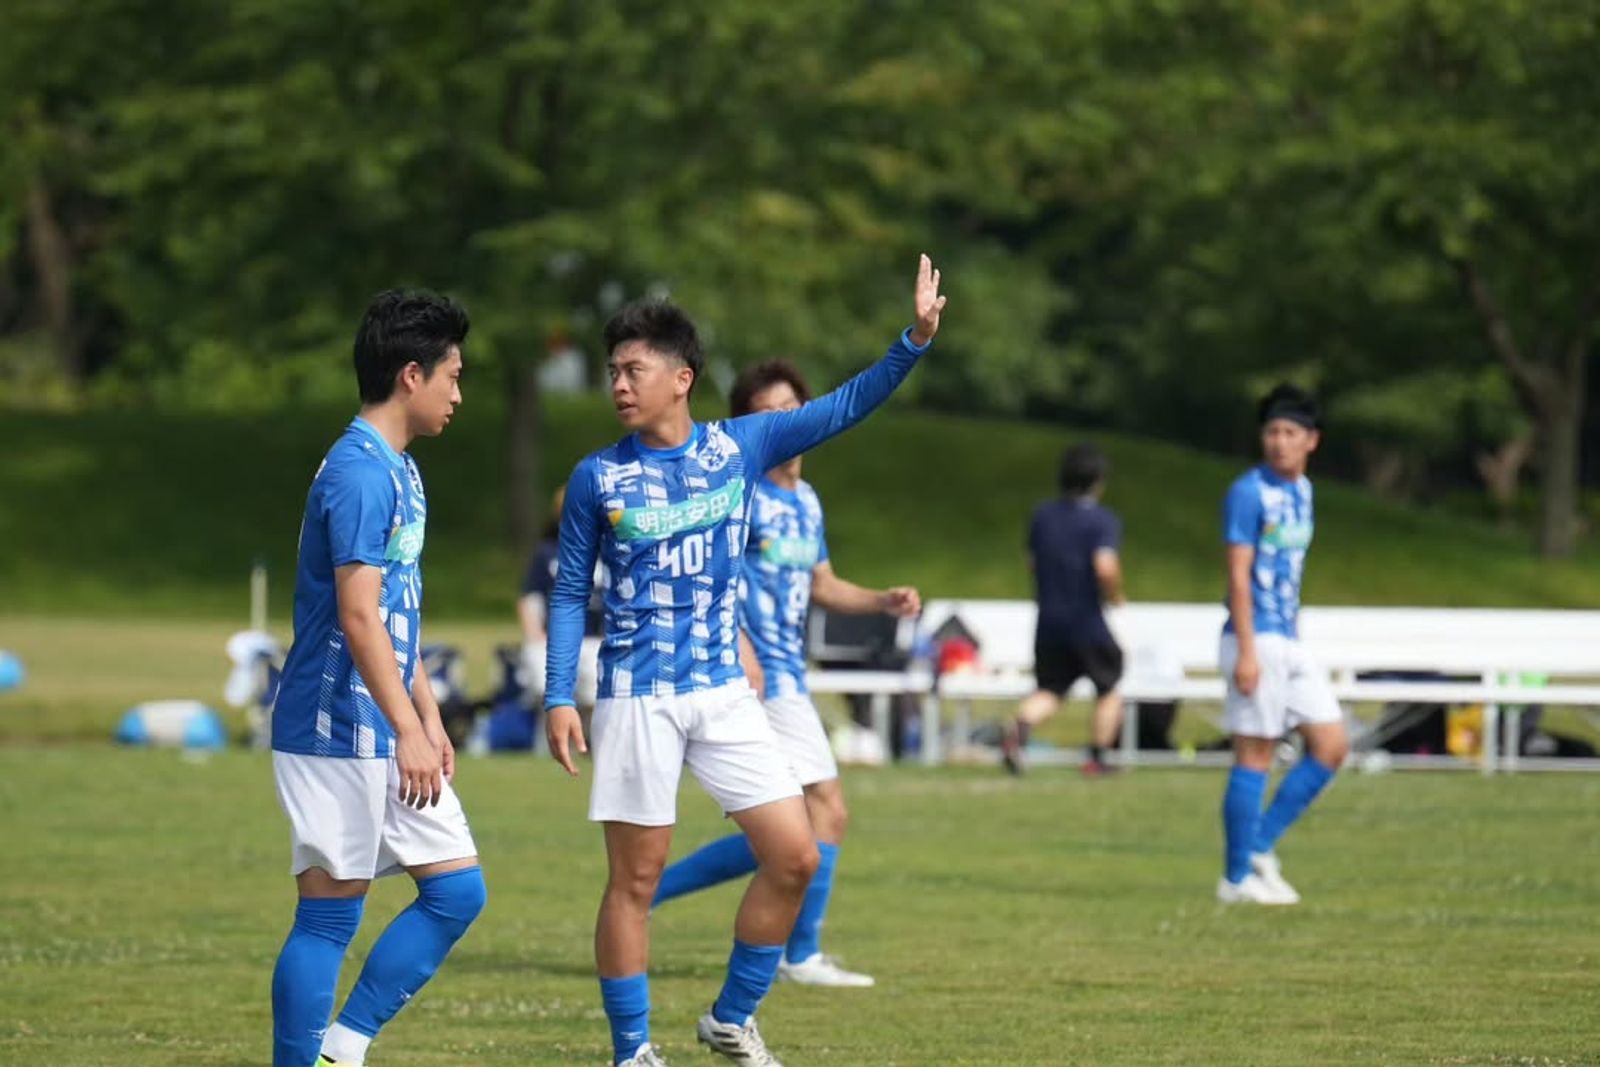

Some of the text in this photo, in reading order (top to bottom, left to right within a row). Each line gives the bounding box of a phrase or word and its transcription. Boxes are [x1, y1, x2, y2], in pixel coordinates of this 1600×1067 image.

[635, 492, 730, 534] 明治安田
[658, 534, 704, 578] 40
